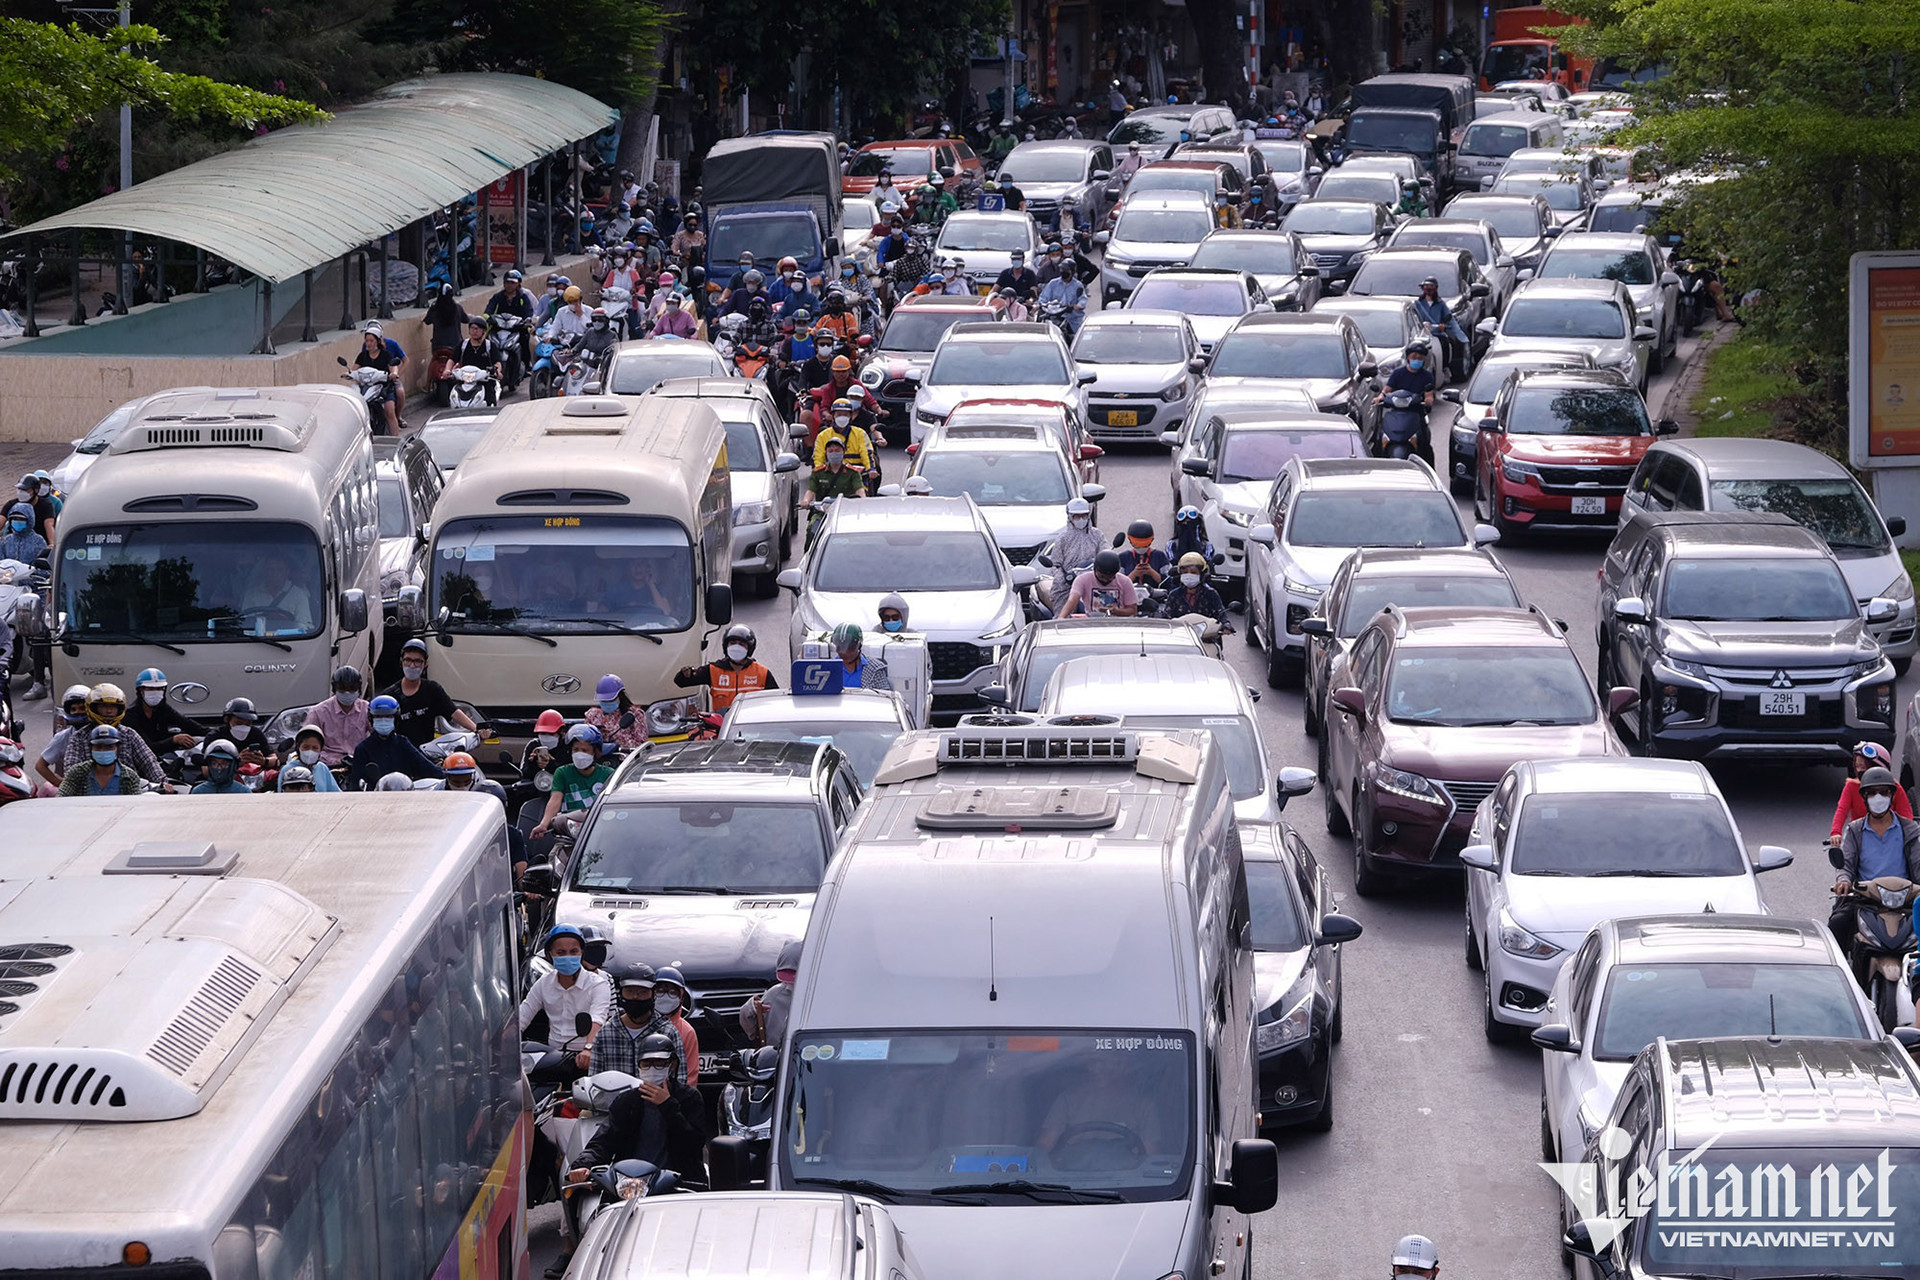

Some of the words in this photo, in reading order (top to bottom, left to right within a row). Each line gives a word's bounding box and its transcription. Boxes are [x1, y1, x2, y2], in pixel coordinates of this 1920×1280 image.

[86, 534, 94, 544] XE
[244, 663, 297, 673] COUNTY
[804, 664, 831, 691] G7
[1773, 693, 1793, 703] 29H
[1765, 704, 1800, 714] 540.51
[1096, 1039, 1112, 1050] XE
[1116, 1037, 1142, 1052] HỢP
[1146, 1034, 1183, 1051] ĐỒNG
